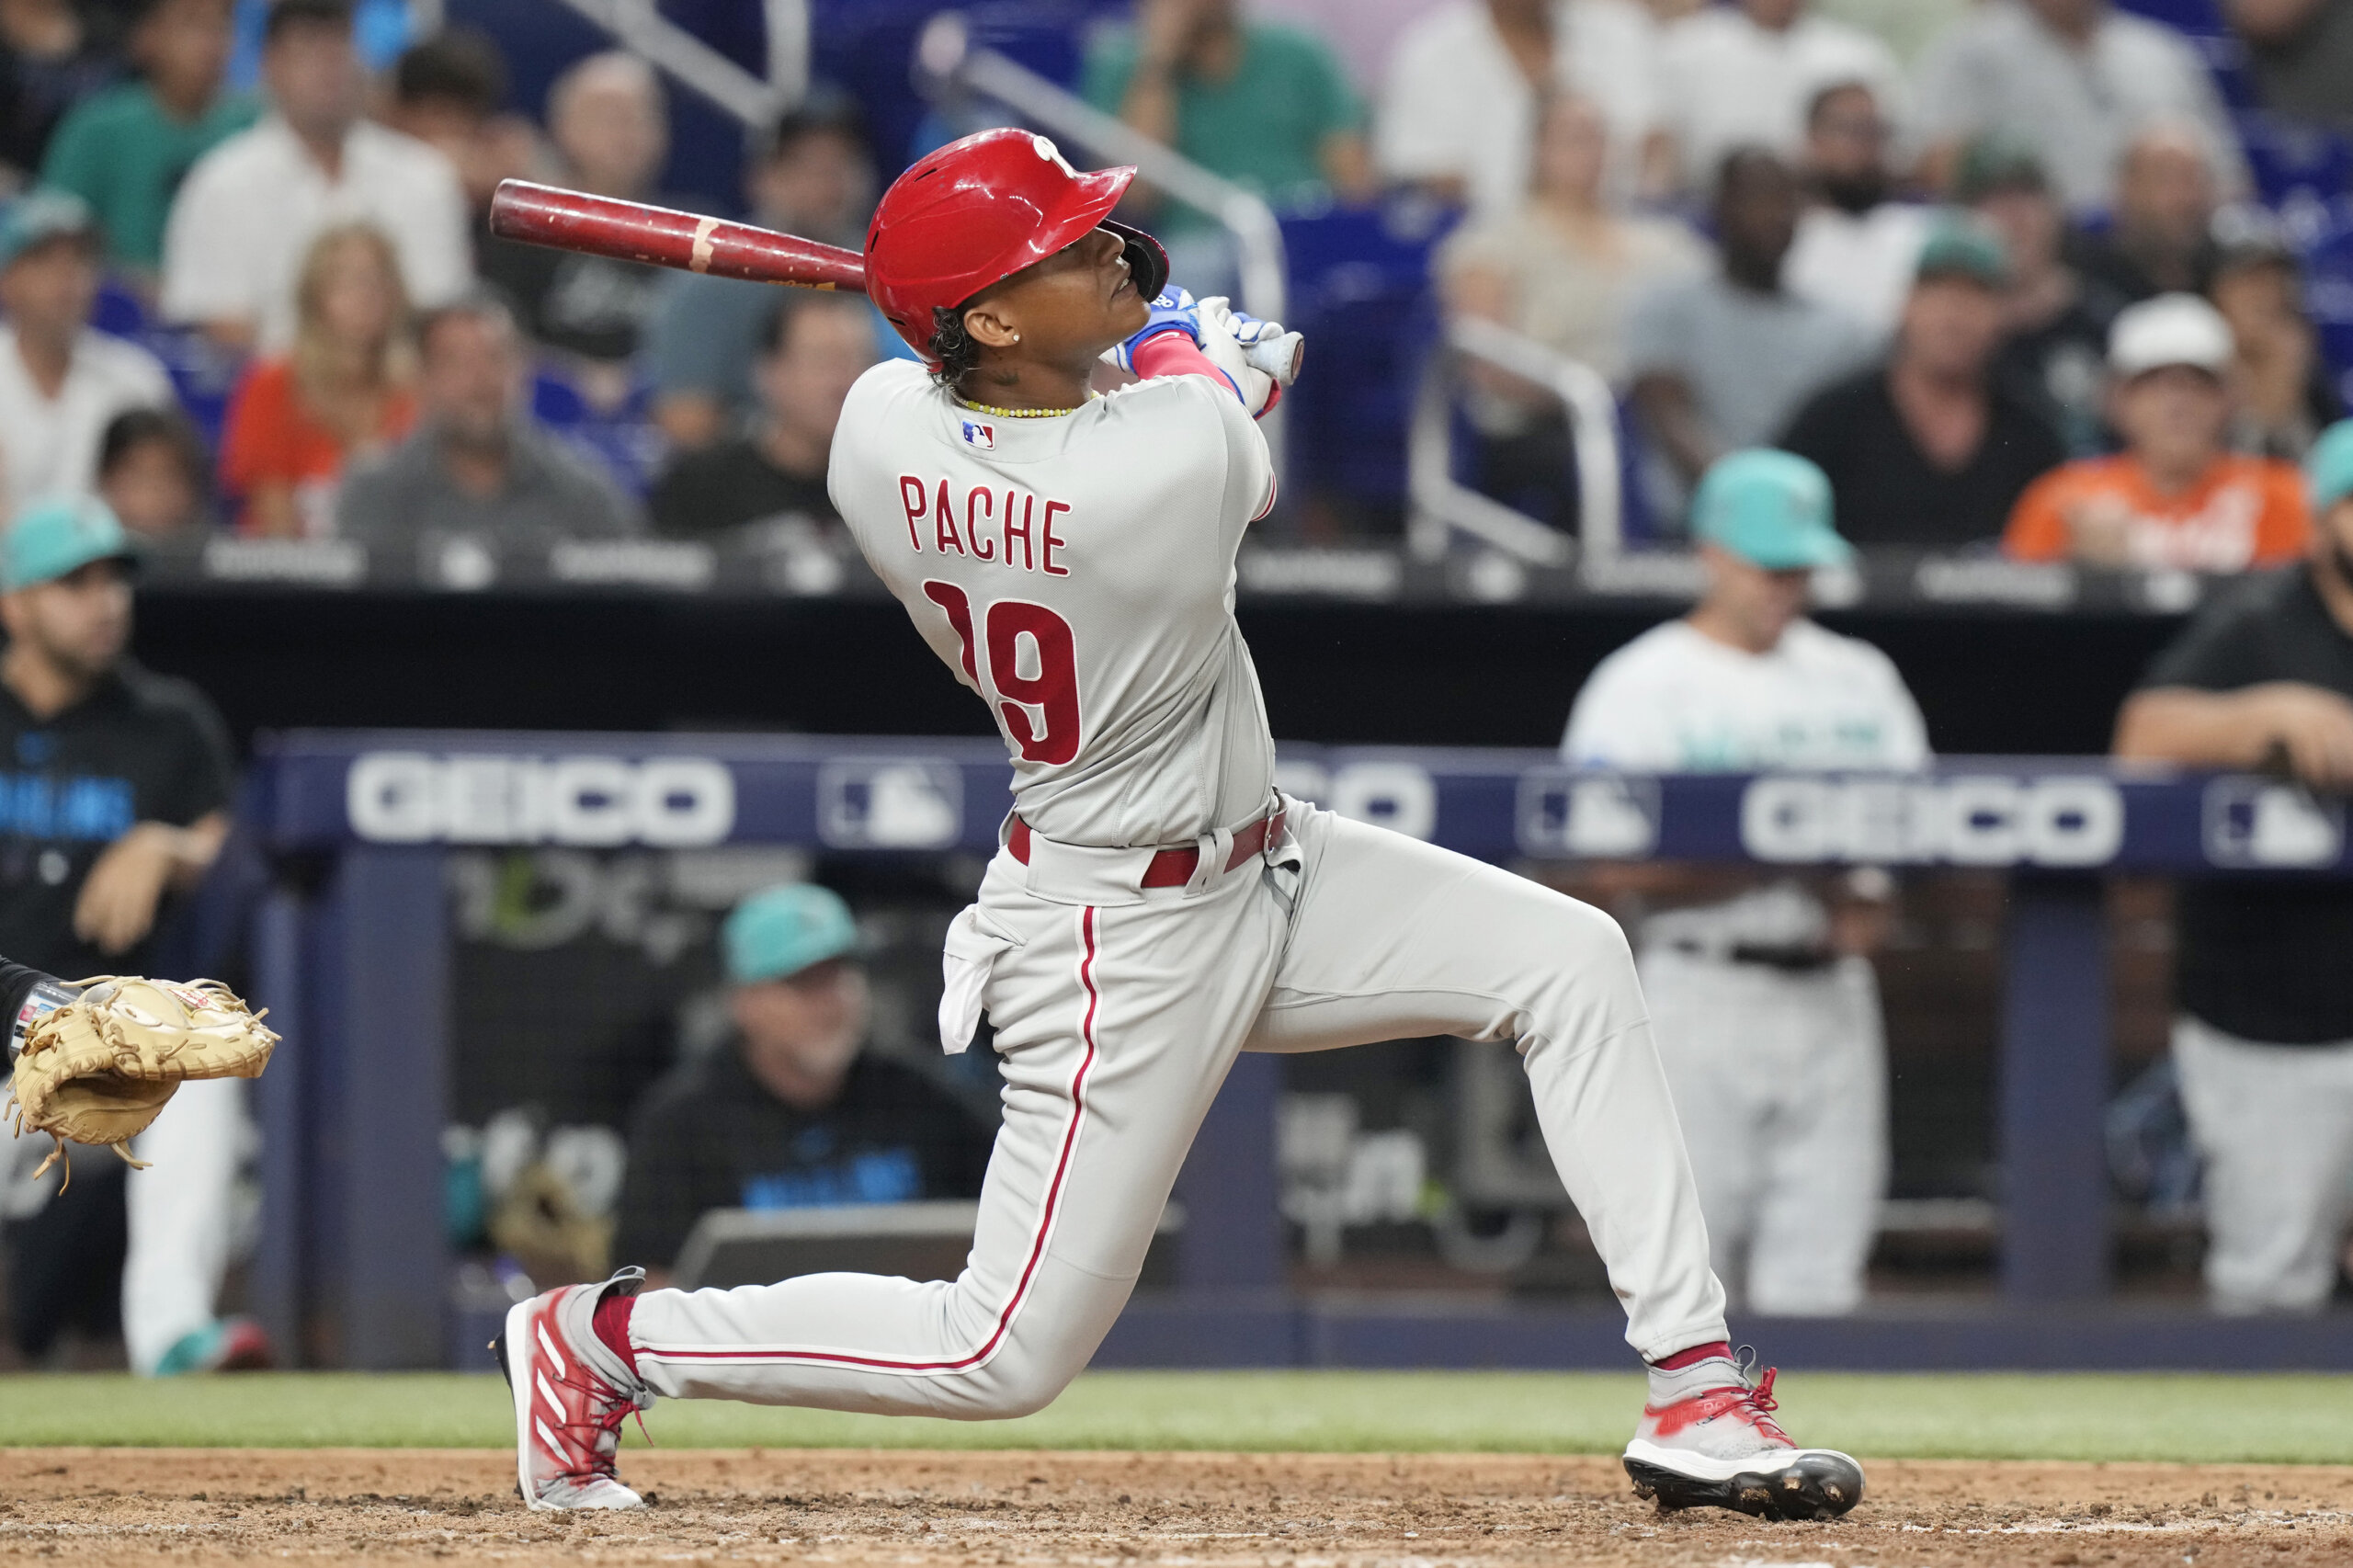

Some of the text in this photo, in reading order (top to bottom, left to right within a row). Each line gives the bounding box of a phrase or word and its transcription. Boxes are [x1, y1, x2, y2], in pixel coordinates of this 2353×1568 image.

[899, 473, 1073, 577] PACHE
[921, 578, 1083, 767] 19
[347, 751, 735, 847] GEICO
[1739, 776, 2127, 868] GEICO
